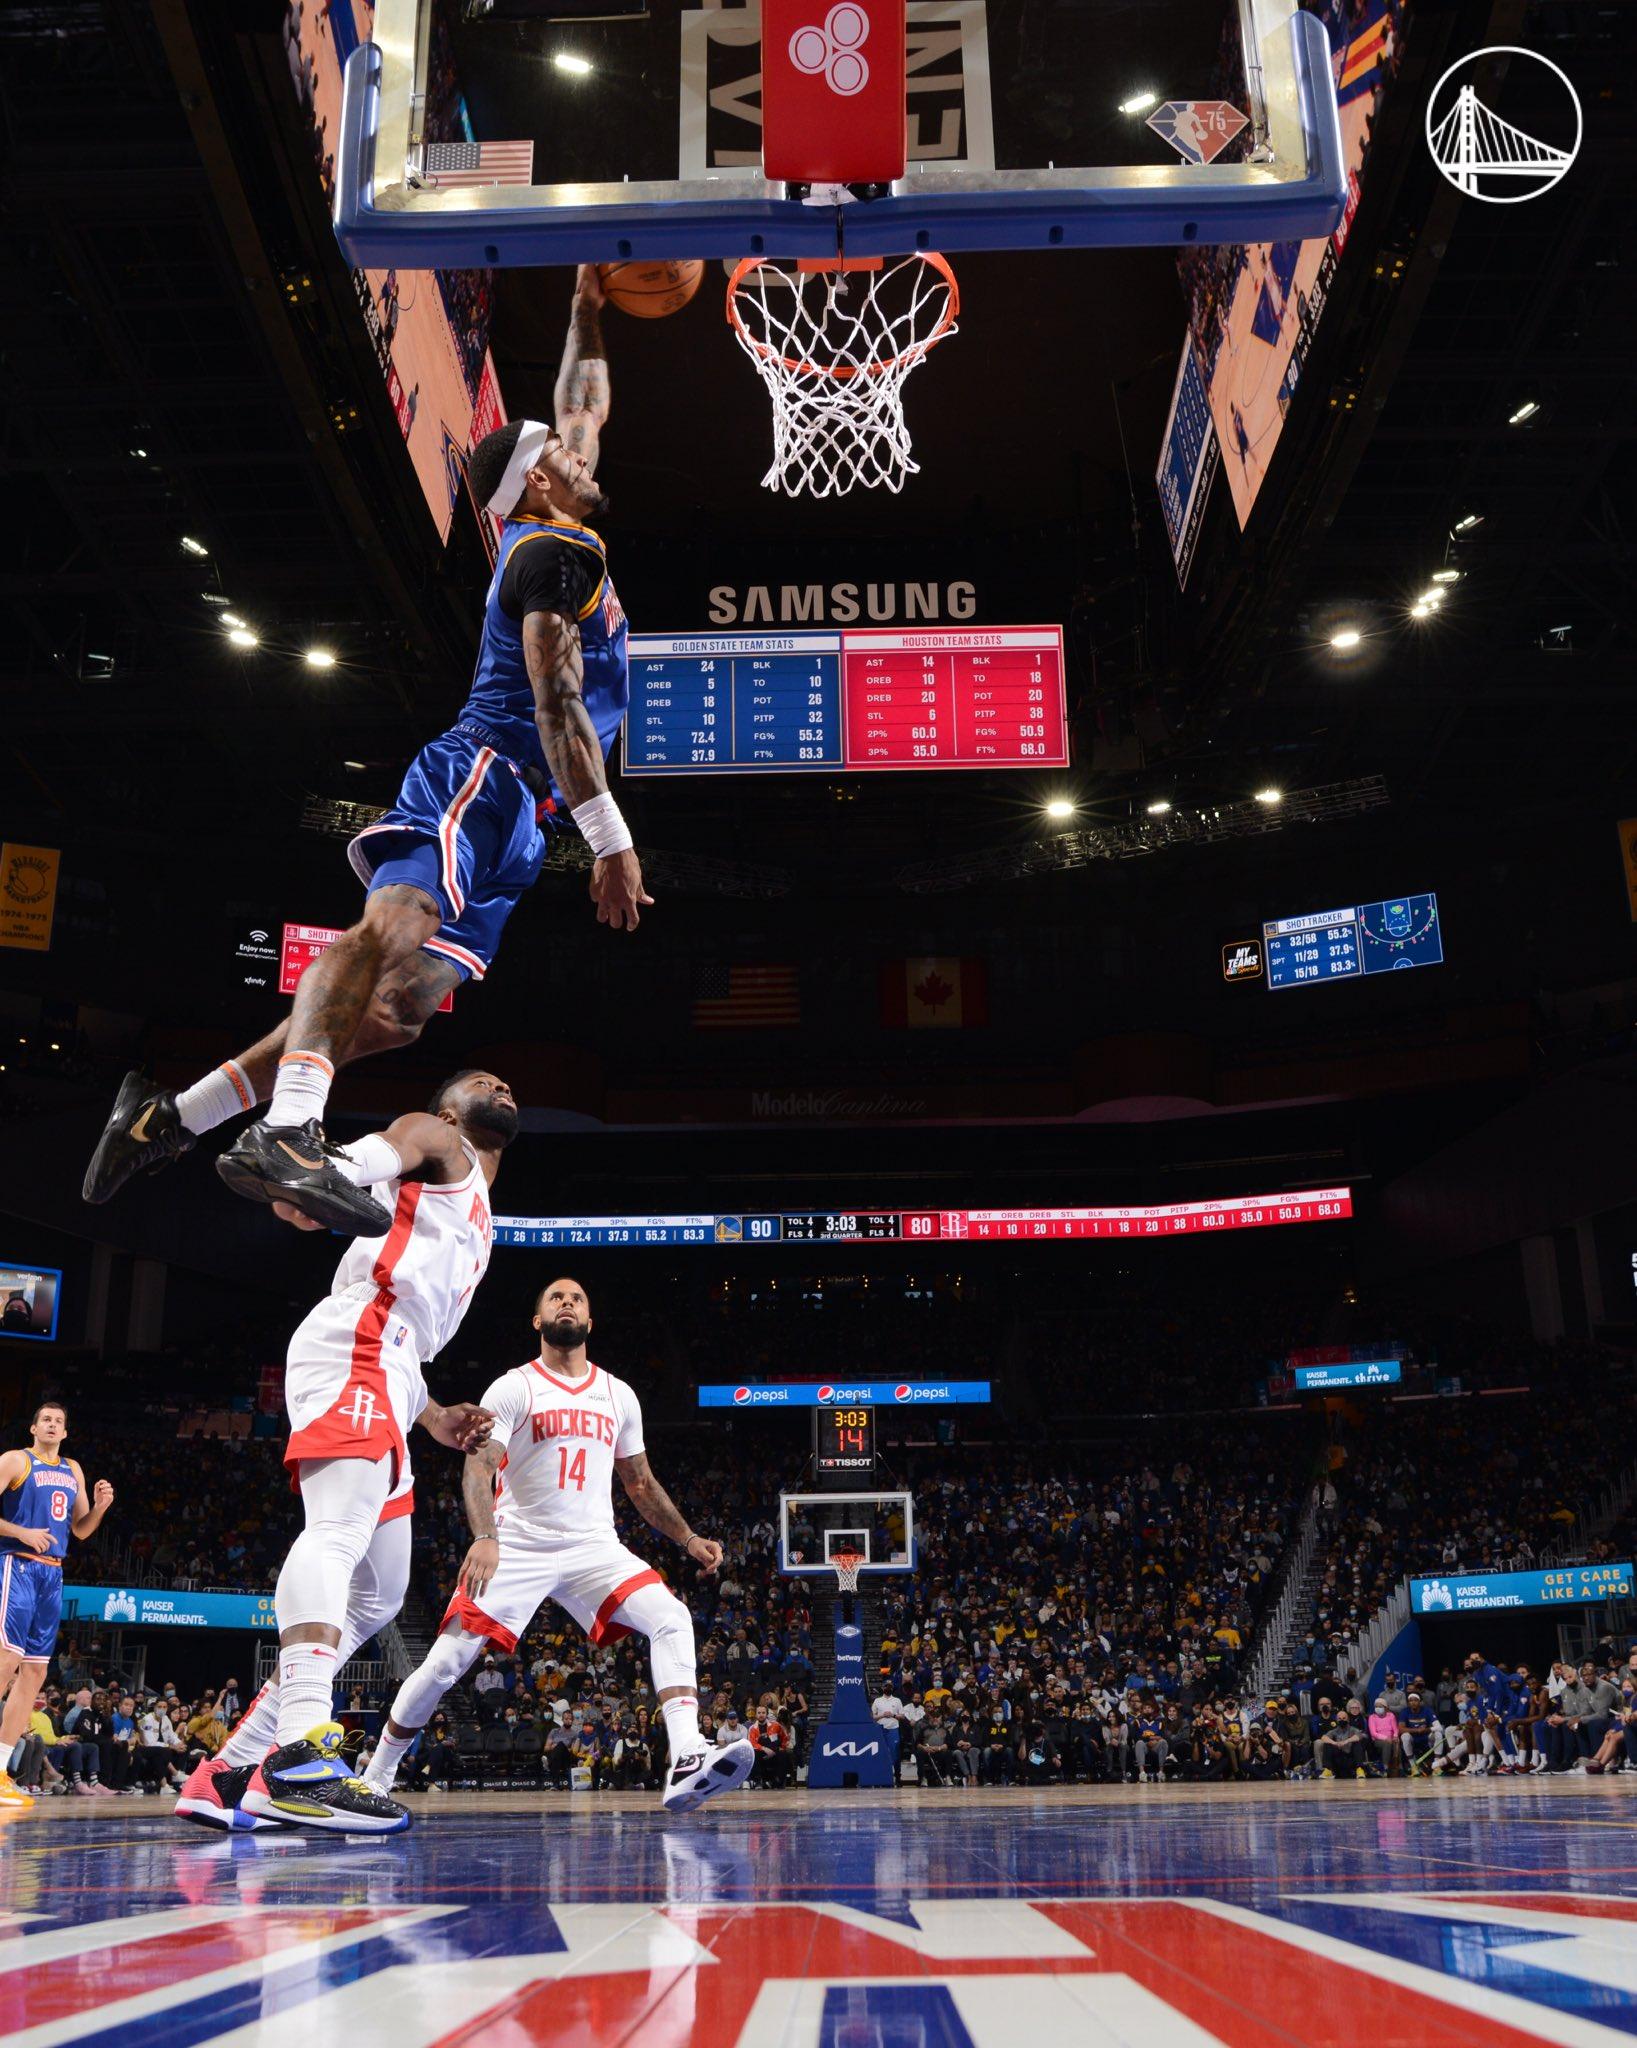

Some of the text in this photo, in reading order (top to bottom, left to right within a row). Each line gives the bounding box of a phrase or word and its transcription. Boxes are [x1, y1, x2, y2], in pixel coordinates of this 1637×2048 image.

[1207, 111, 1226, 130] 75
[708, 581, 976, 624] SAMSUNG
[673, 640, 793, 652] GOLDEN STATE TEAM STATS
[902, 635, 1002, 646] HOUSTON TEAM STATS
[816, 658, 821, 669] 1
[923, 656, 934, 667] 14
[1035, 654, 1040, 665] 1
[701, 661, 714, 672] 24
[810, 676, 821, 687] 10
[923, 674, 934, 685] 10
[1030, 672, 1041, 683] 18
[708, 678, 714, 689] 5
[808, 694, 822, 705] 26
[922, 691, 935, 703] 20
[974, 690, 1042, 700] POT 20
[703, 696, 714, 707] 18
[809, 712, 822, 722] 32
[929, 709, 936, 720] 6
[1030, 707, 1043, 718] 38
[703, 714, 714, 725] 10
[799, 730, 823, 740] 55.2
[868, 727, 936, 738] 2P% 60.0
[1020, 725, 1044, 736] 50.9
[692, 732, 715, 743] 72.4
[800, 748, 823, 758] 83.3
[913, 745, 937, 756] 35.0
[977, 743, 1044, 754] FT% 68.0
[692, 750, 715, 761] 37.9
[1287, 913, 1342, 929] SHOT TRACKER
[308, 930, 327, 939] SHOT
[1290, 933, 1317, 946] 32/58
[240, 944, 258, 952] Enjoy
[1236, 947, 1250, 958] MY
[1295, 949, 1318, 962] 11/29
[1228, 955, 1258, 968] TEAMS
[1295, 966, 1318, 978] 15/18
[808, 1217, 813, 1225] 4
[826, 1216, 856, 1230] 3:03
[888, 1216, 894, 1224] 4
[979, 1203, 1340, 1234] 14 10 20 6 1 18 20 38 60.0 35.0 50.9 68.0
[751, 1220, 771, 1237] 90
[911, 1218, 931, 1234] 80
[514, 1230, 704, 1242] 26 32 72.4 37.9 55.2 83.3
[808, 1230, 813, 1238] 4
[889, 1229, 894, 1237] 4
[1355, 1373, 1389, 1383] thrive
[754, 1389, 787, 1402] pepsi
[836, 1388, 872, 1401] pepsi
[911, 1387, 949, 1400] pepsi
[835, 1412, 866, 1426] 3:03
[532, 1409, 614, 1447] ROCKETS
[841, 1430, 862, 1451] 14
[559, 1447, 586, 1491] 14
[51, 1491, 68, 1521] 8
[1545, 1569, 1620, 1585] GET CARE
[1456, 1586, 1487, 1596] KAISER
[1541, 1583, 1628, 1600] LIKE A PRO
[143, 1600, 173, 1611] KAISER
[838, 1676, 862, 1686] xfinity
